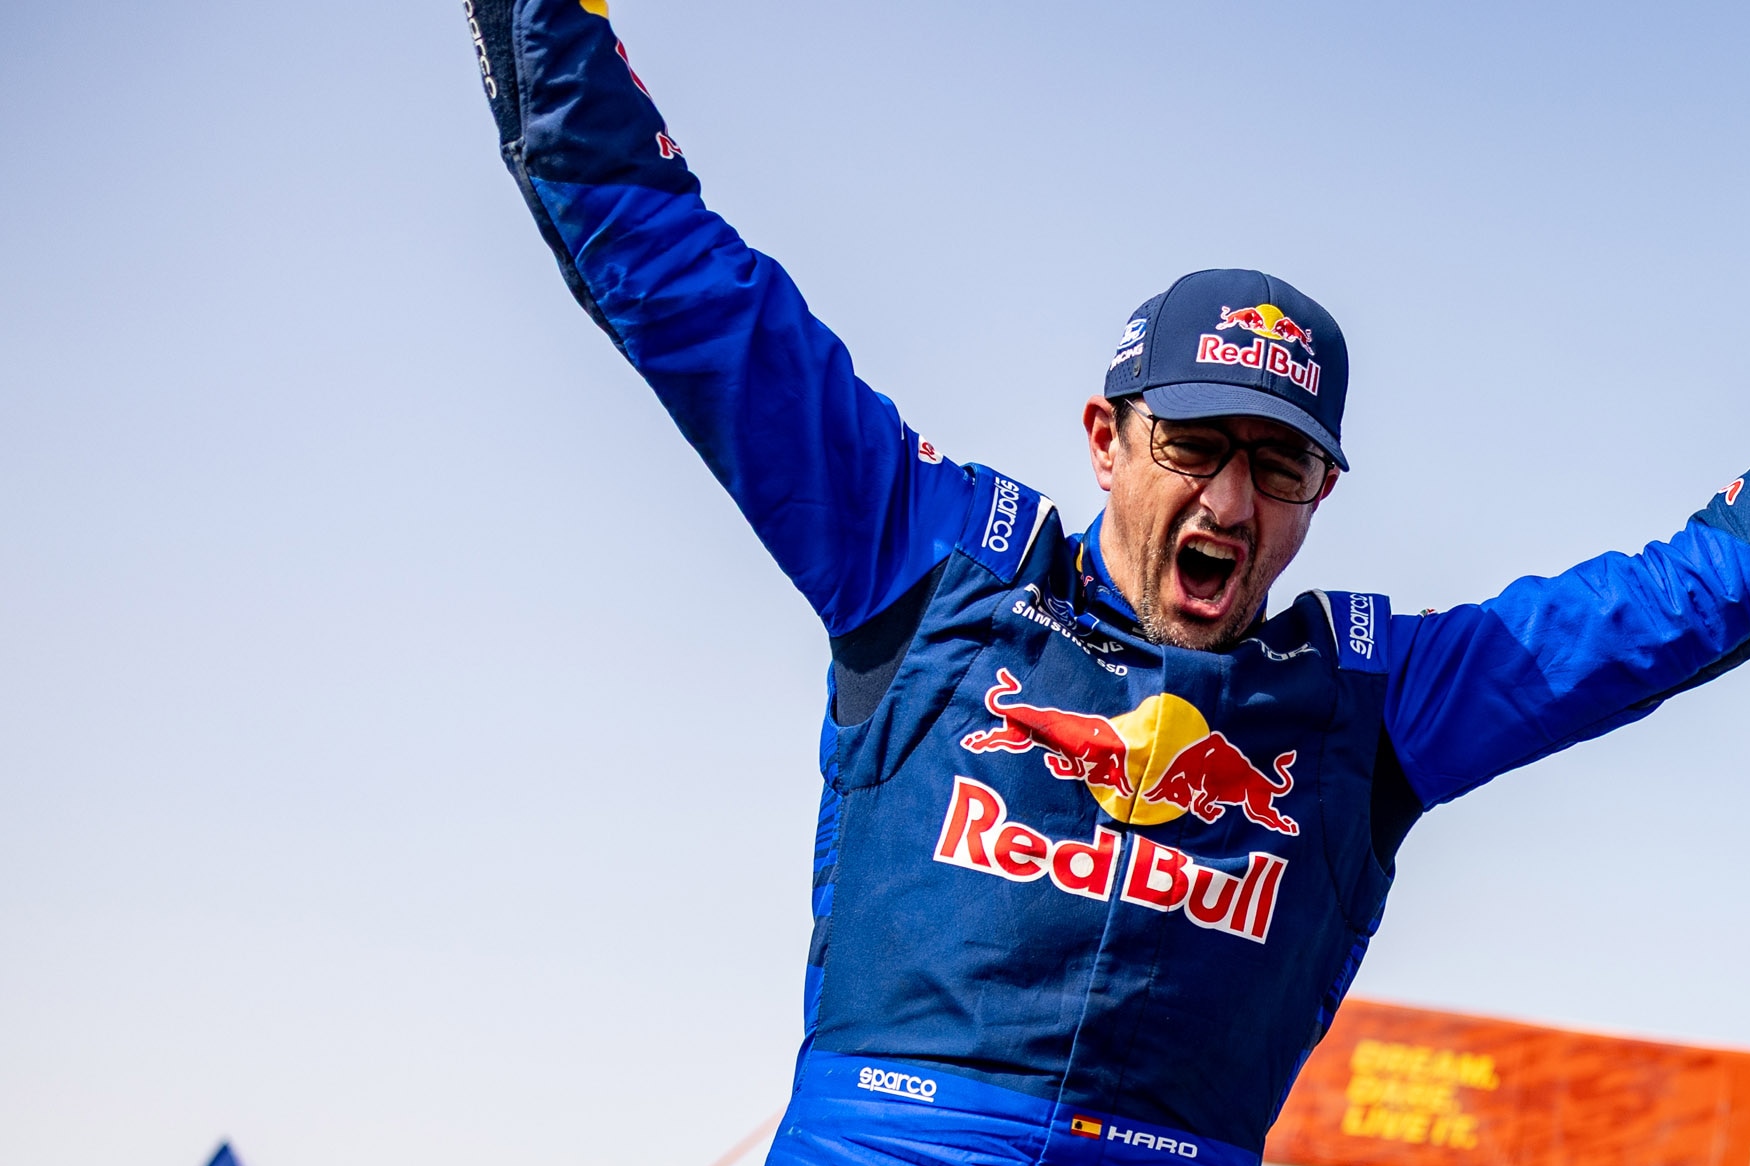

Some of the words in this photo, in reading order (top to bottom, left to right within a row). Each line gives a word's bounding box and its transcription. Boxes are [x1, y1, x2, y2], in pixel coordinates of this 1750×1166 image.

[1196, 334, 1266, 369] Red
[1267, 342, 1320, 396] Bull
[982, 476, 1020, 552] sparco
[1350, 593, 1375, 660] sparco
[1097, 658, 1129, 677] SSD
[933, 775, 1122, 902] Red
[1120, 832, 1289, 945] Bull
[857, 1065, 938, 1103] sparco
[1106, 1125, 1199, 1159] HARO
